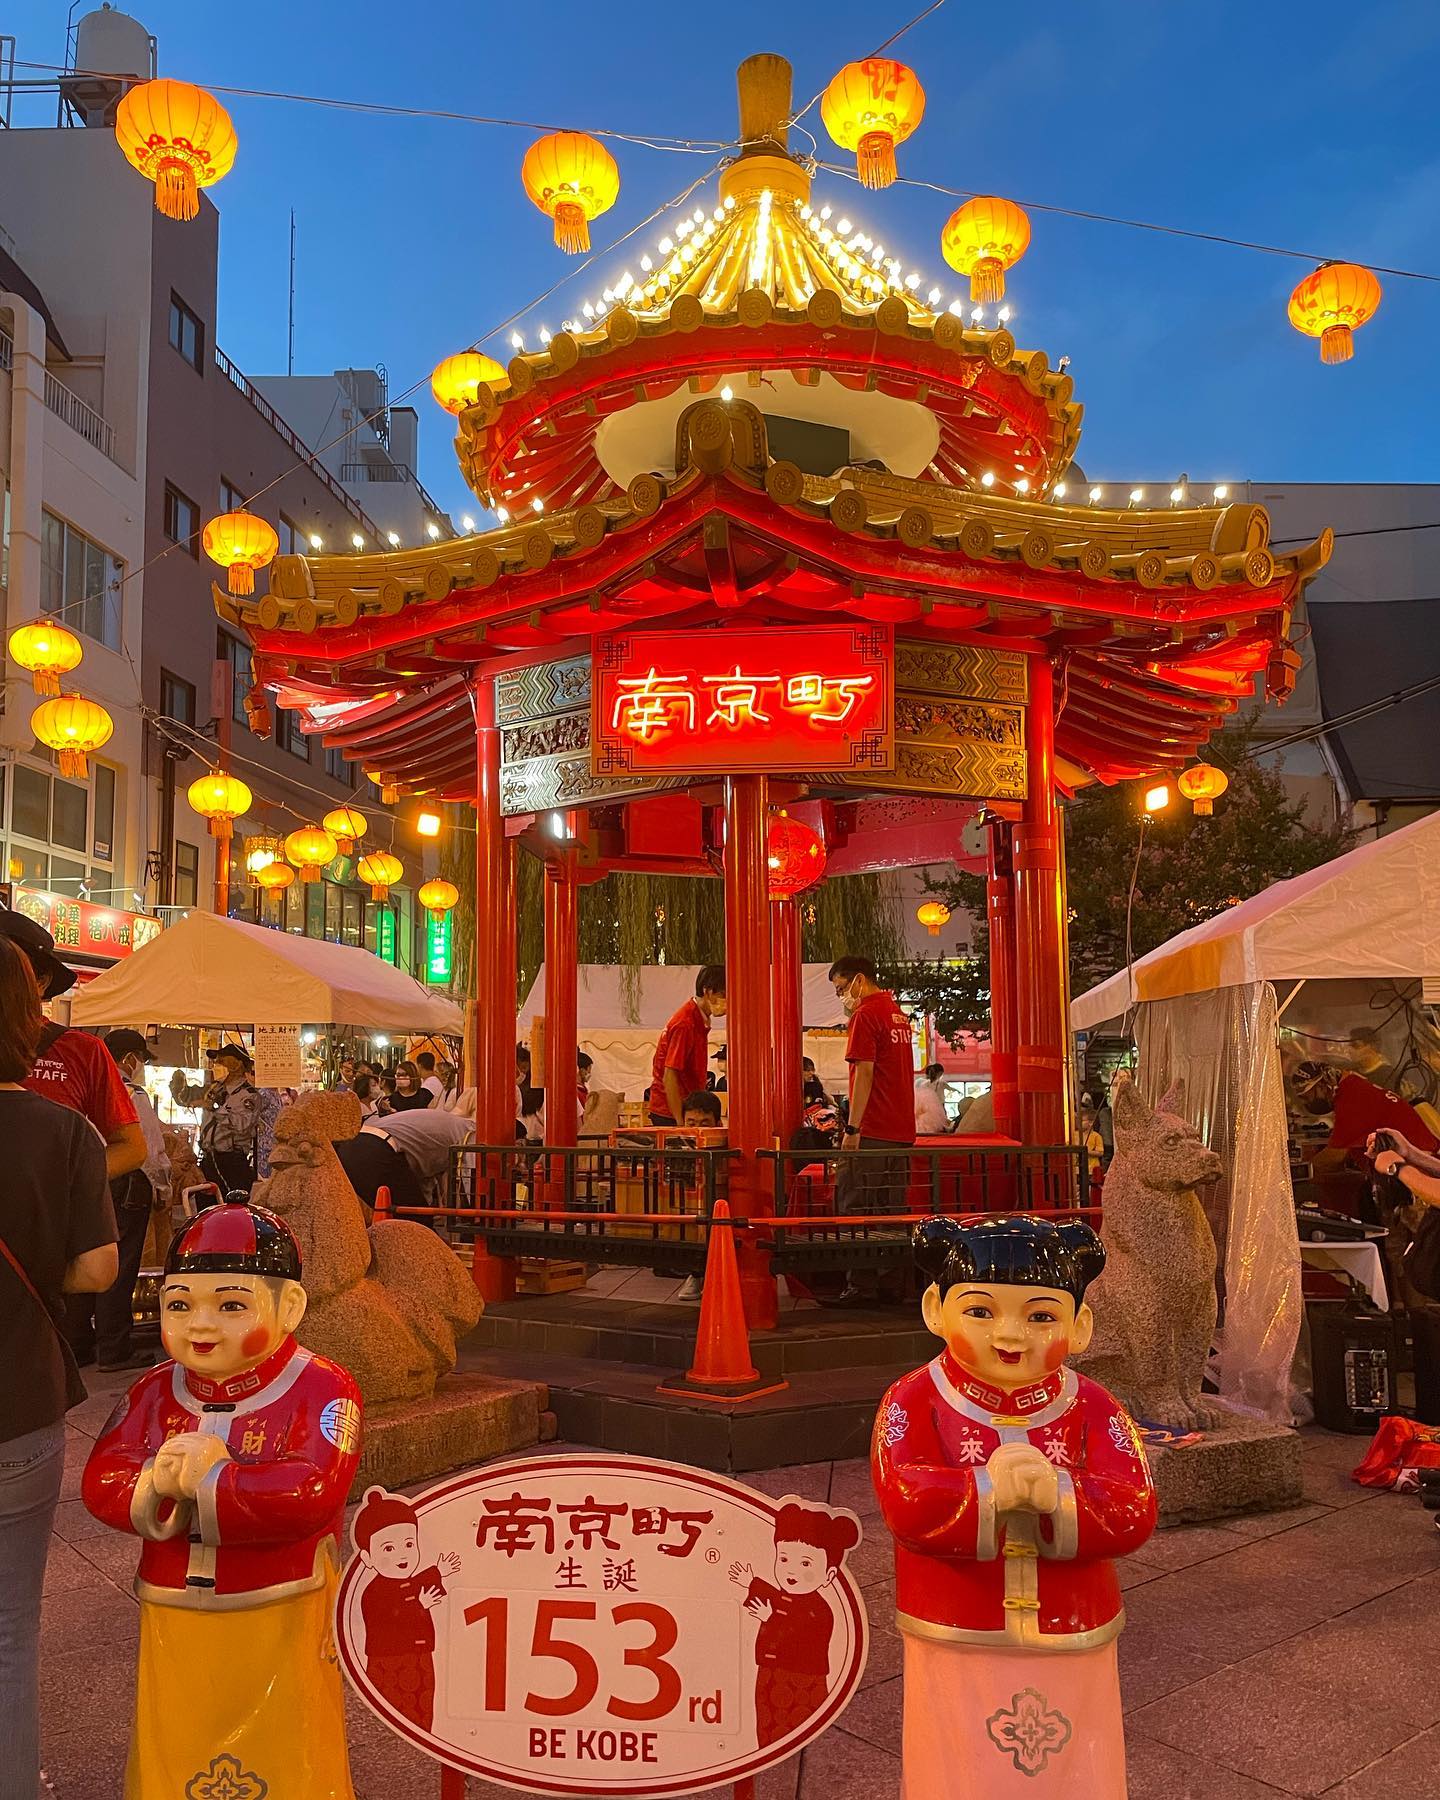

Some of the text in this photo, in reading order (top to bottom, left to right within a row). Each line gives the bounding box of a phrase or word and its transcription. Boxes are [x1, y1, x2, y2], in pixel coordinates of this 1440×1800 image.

[612, 666, 873, 736] 南京町
[239, 1430, 267, 1455] 財
[959, 1437, 987, 1464] 來
[1044, 1437, 1072, 1464] 來
[476, 1492, 714, 1558] 南京町
[554, 1556, 639, 1592] 生誕
[529, 1727, 658, 1763] BE KOBE
